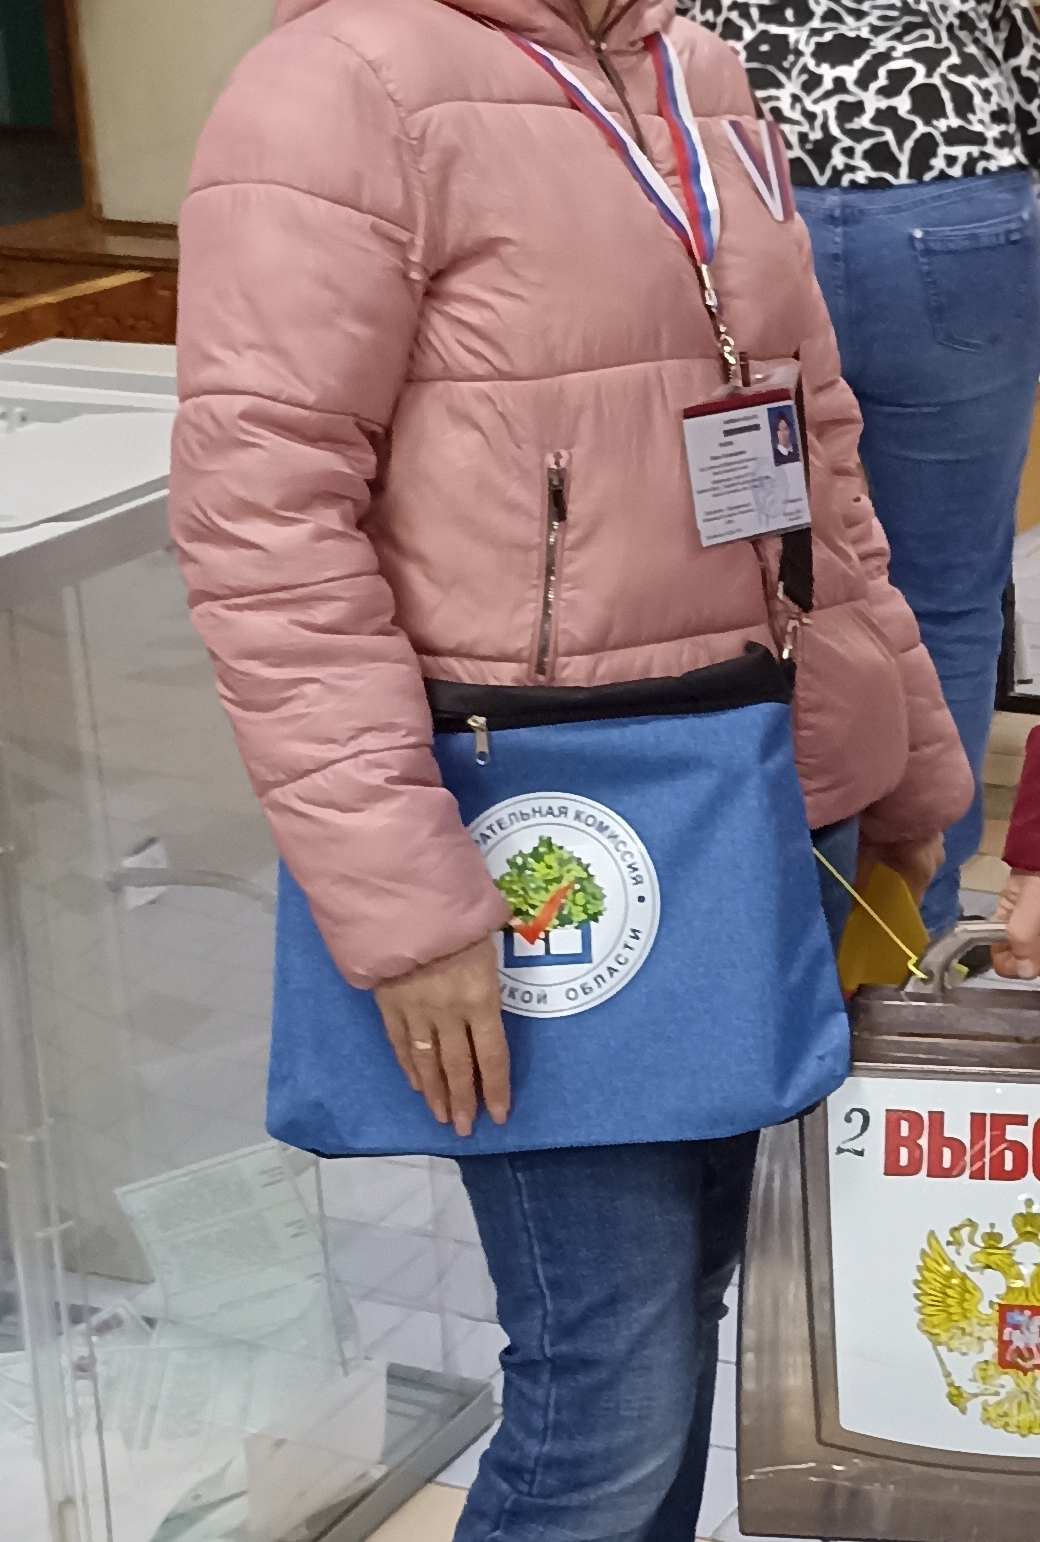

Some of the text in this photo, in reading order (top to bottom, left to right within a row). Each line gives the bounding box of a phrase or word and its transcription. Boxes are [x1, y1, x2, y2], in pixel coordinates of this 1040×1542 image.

[573, 809, 645, 887] КОМИССИЯ
[565, 928, 643, 1001] ОБЛАСТИ
[835, 1107, 870, 1157] 2
